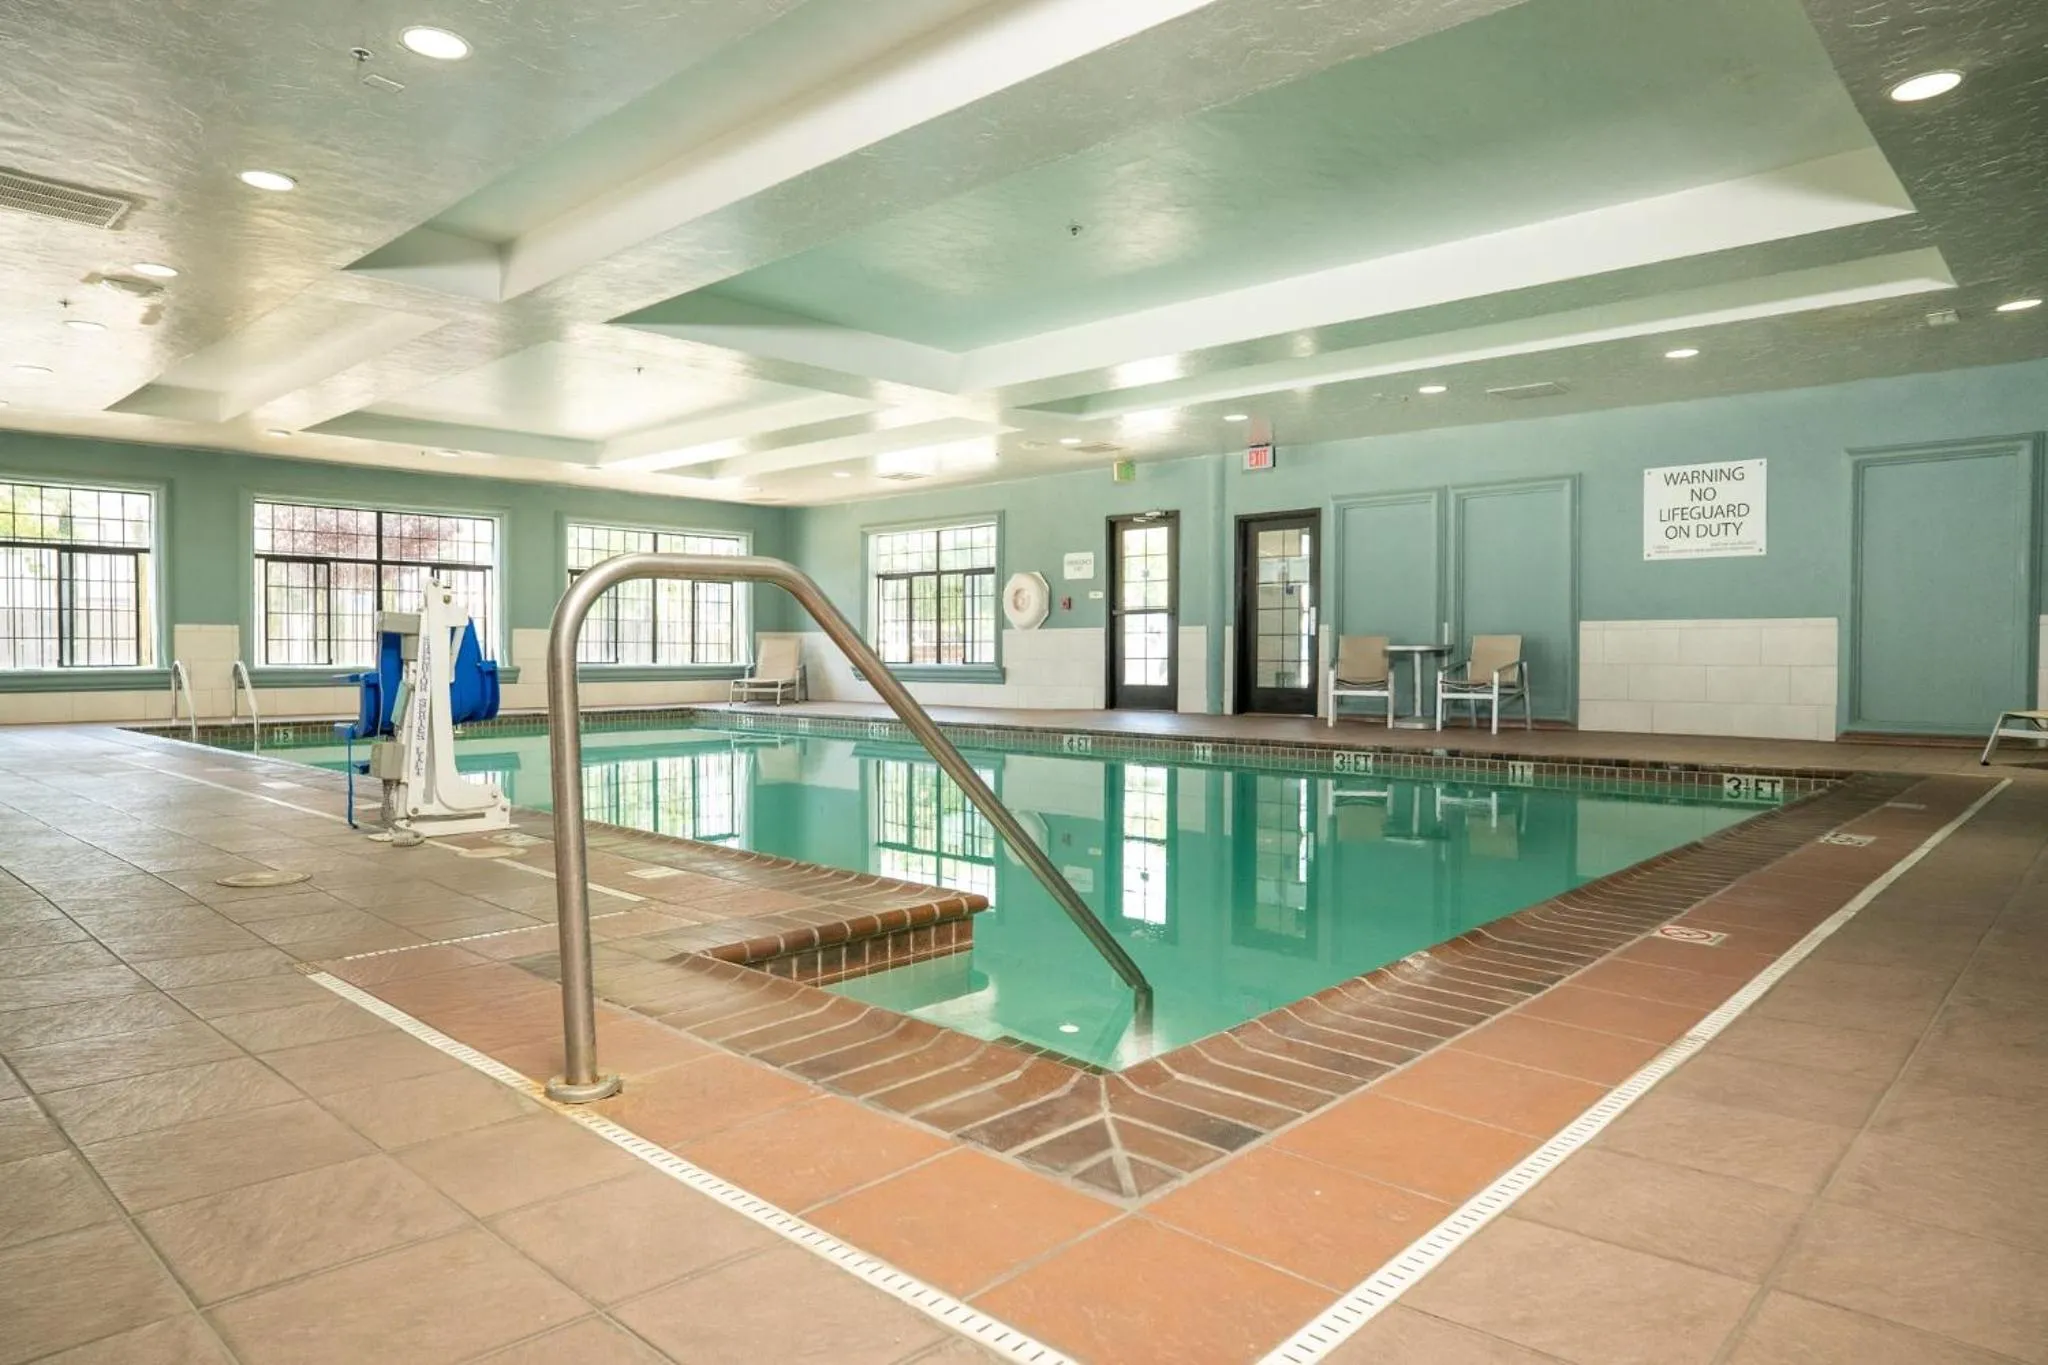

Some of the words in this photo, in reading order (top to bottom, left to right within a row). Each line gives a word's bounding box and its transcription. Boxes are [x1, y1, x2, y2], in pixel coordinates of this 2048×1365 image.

[1249, 449, 1267, 466] EXIT
[1664, 466, 1745, 487] WARNING
[1690, 487, 1717, 502] NO
[1659, 503, 1750, 522] LIFEGUARD
[1665, 525, 1690, 540] ON
[1696, 521, 1743, 538] DUTY
